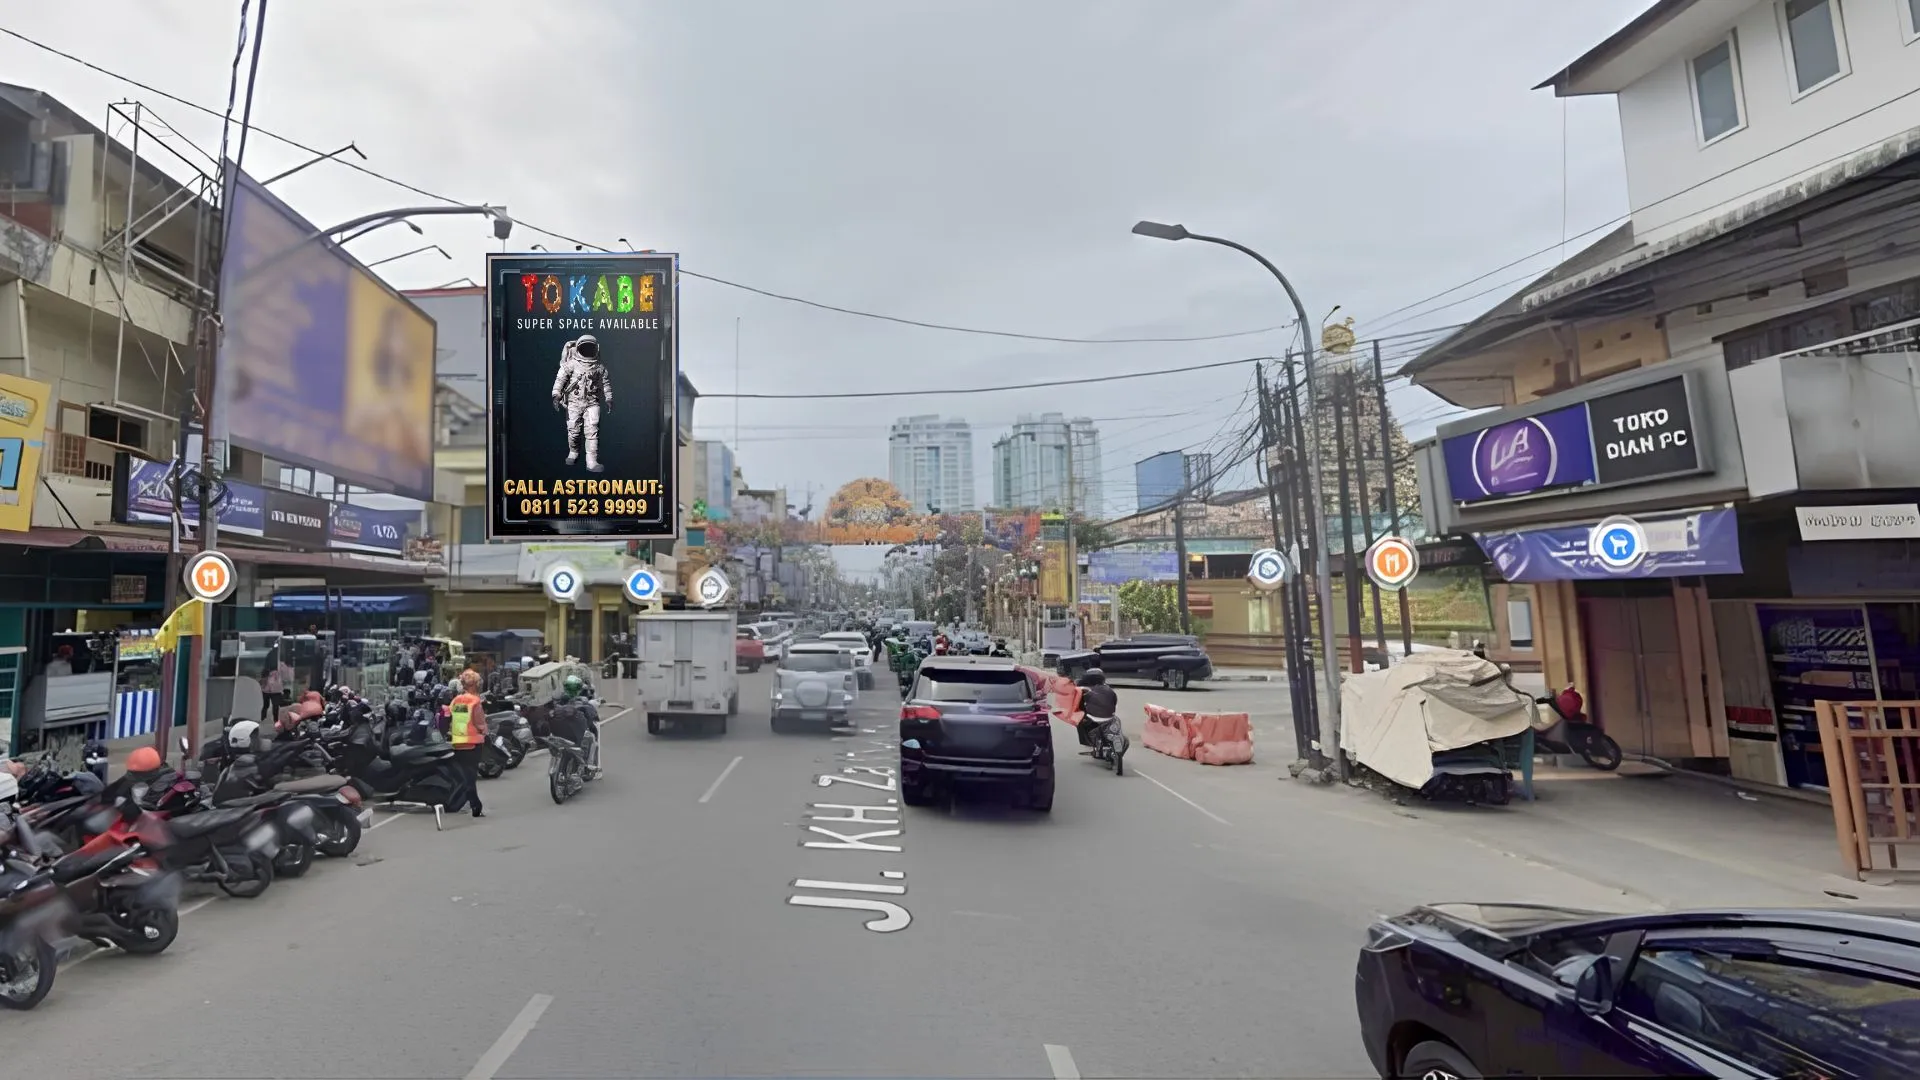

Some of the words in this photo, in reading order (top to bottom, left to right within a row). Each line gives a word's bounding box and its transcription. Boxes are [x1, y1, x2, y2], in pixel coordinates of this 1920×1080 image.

[522, 274, 656, 313] TOKABE
[517, 318, 553, 330] SUPER
[559, 318, 594, 330] SPACE
[600, 318, 659, 329] AVAILABLE
[1612, 408, 1669, 433] TOKO
[1659, 430, 1688, 449] PC
[504, 479, 548, 495] CALL
[553, 479, 664, 495] ASTRONAUT:
[520, 498, 561, 515] 0811
[567, 498, 599, 515] 523
[604, 498, 648, 515] 9999
